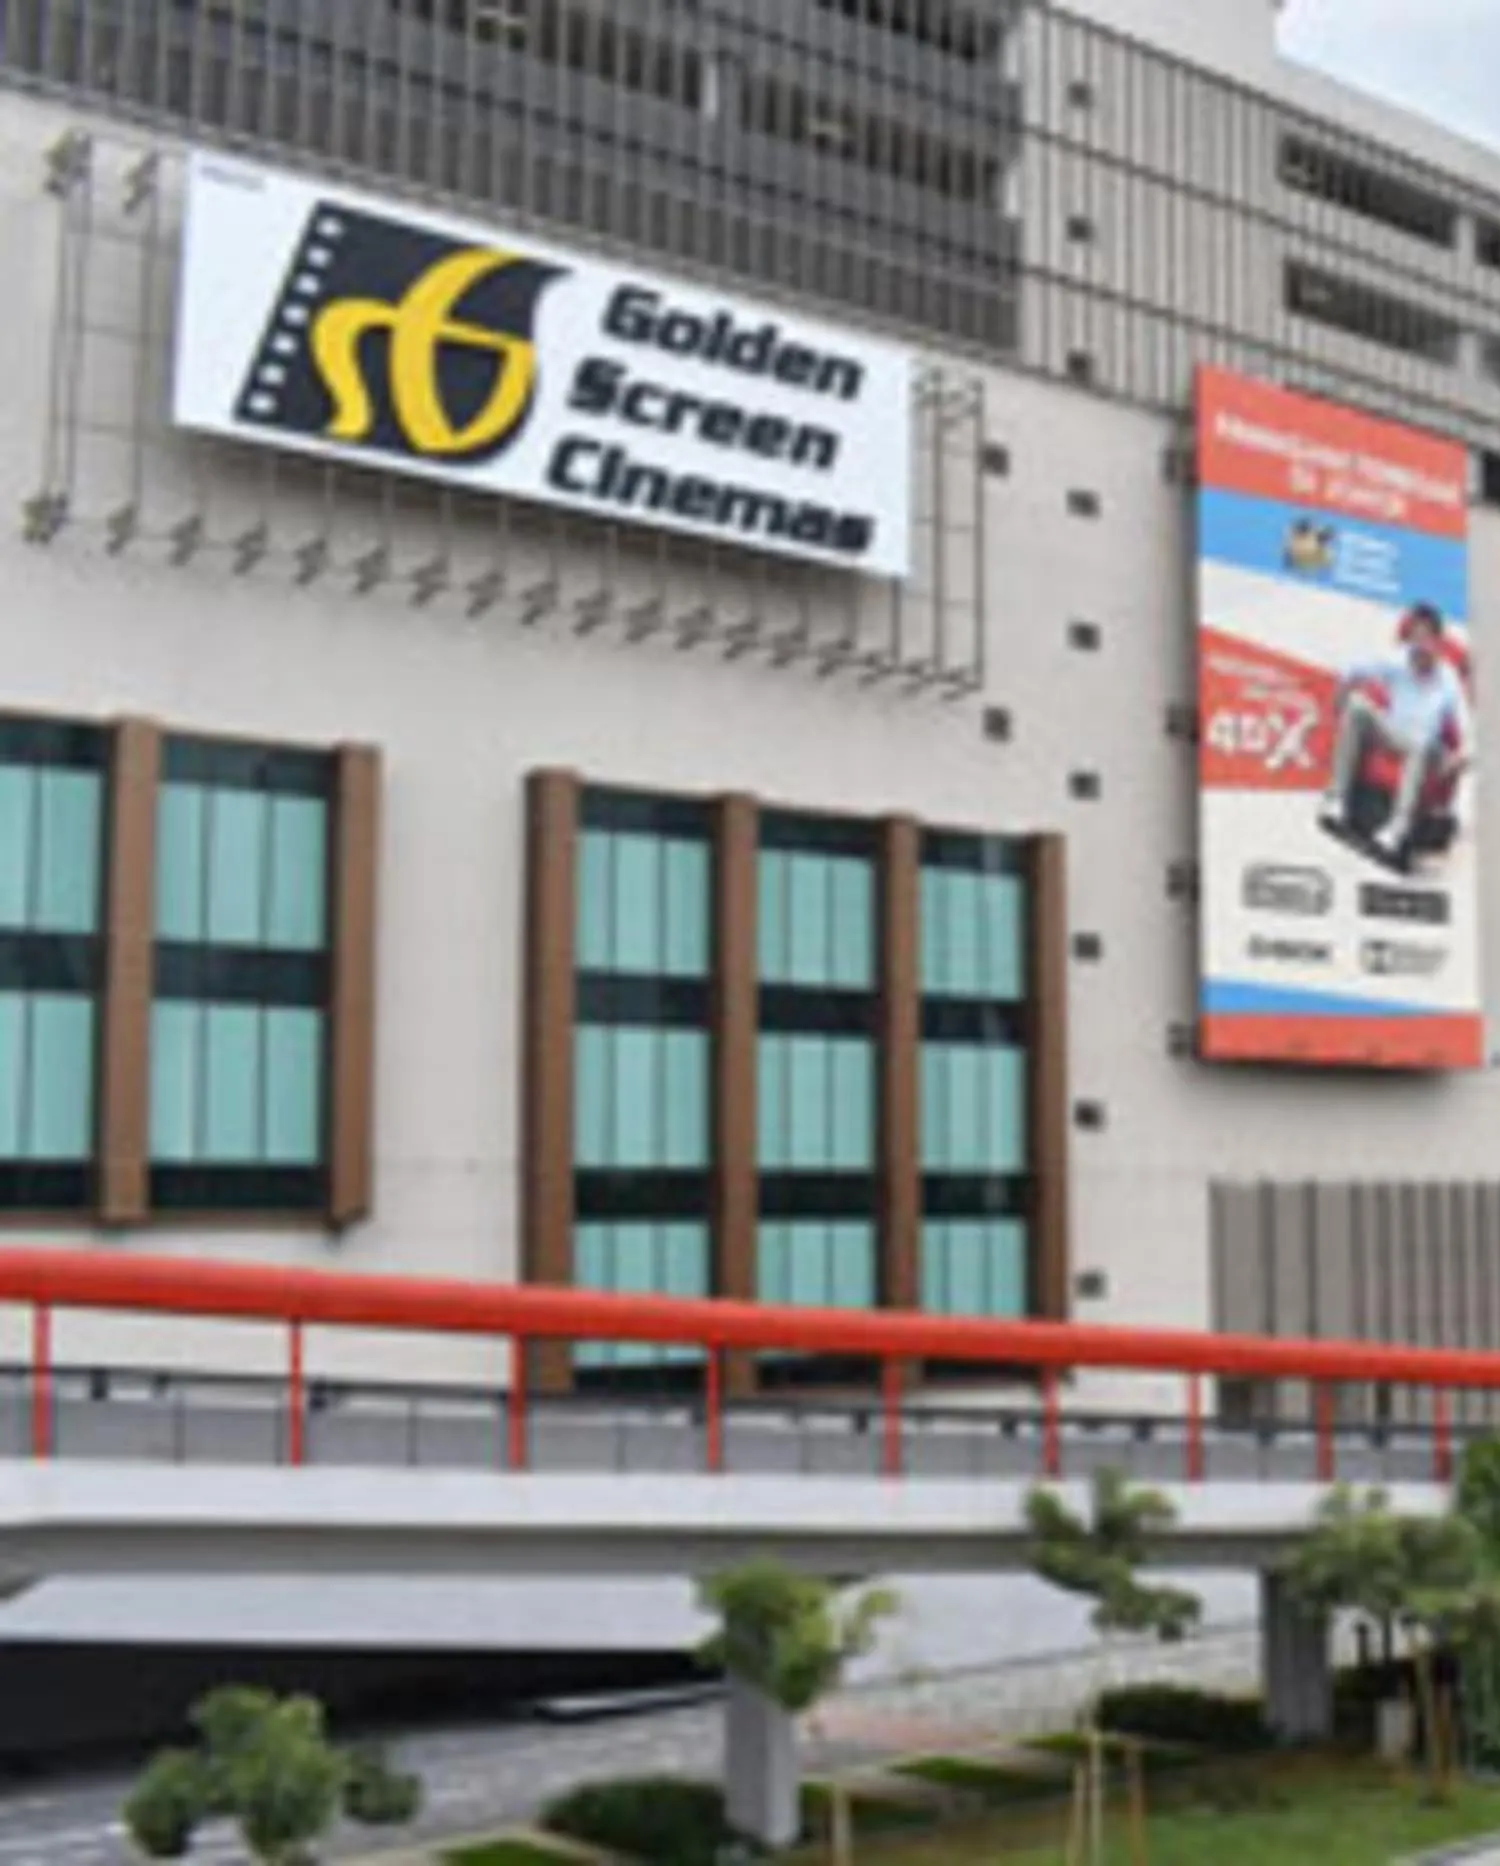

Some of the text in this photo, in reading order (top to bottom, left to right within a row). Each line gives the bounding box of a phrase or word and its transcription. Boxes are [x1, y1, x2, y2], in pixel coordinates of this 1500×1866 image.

[601, 283, 865, 402] Golden
[566, 354, 841, 472] Screen
[545, 430, 876, 557] Cinemas
